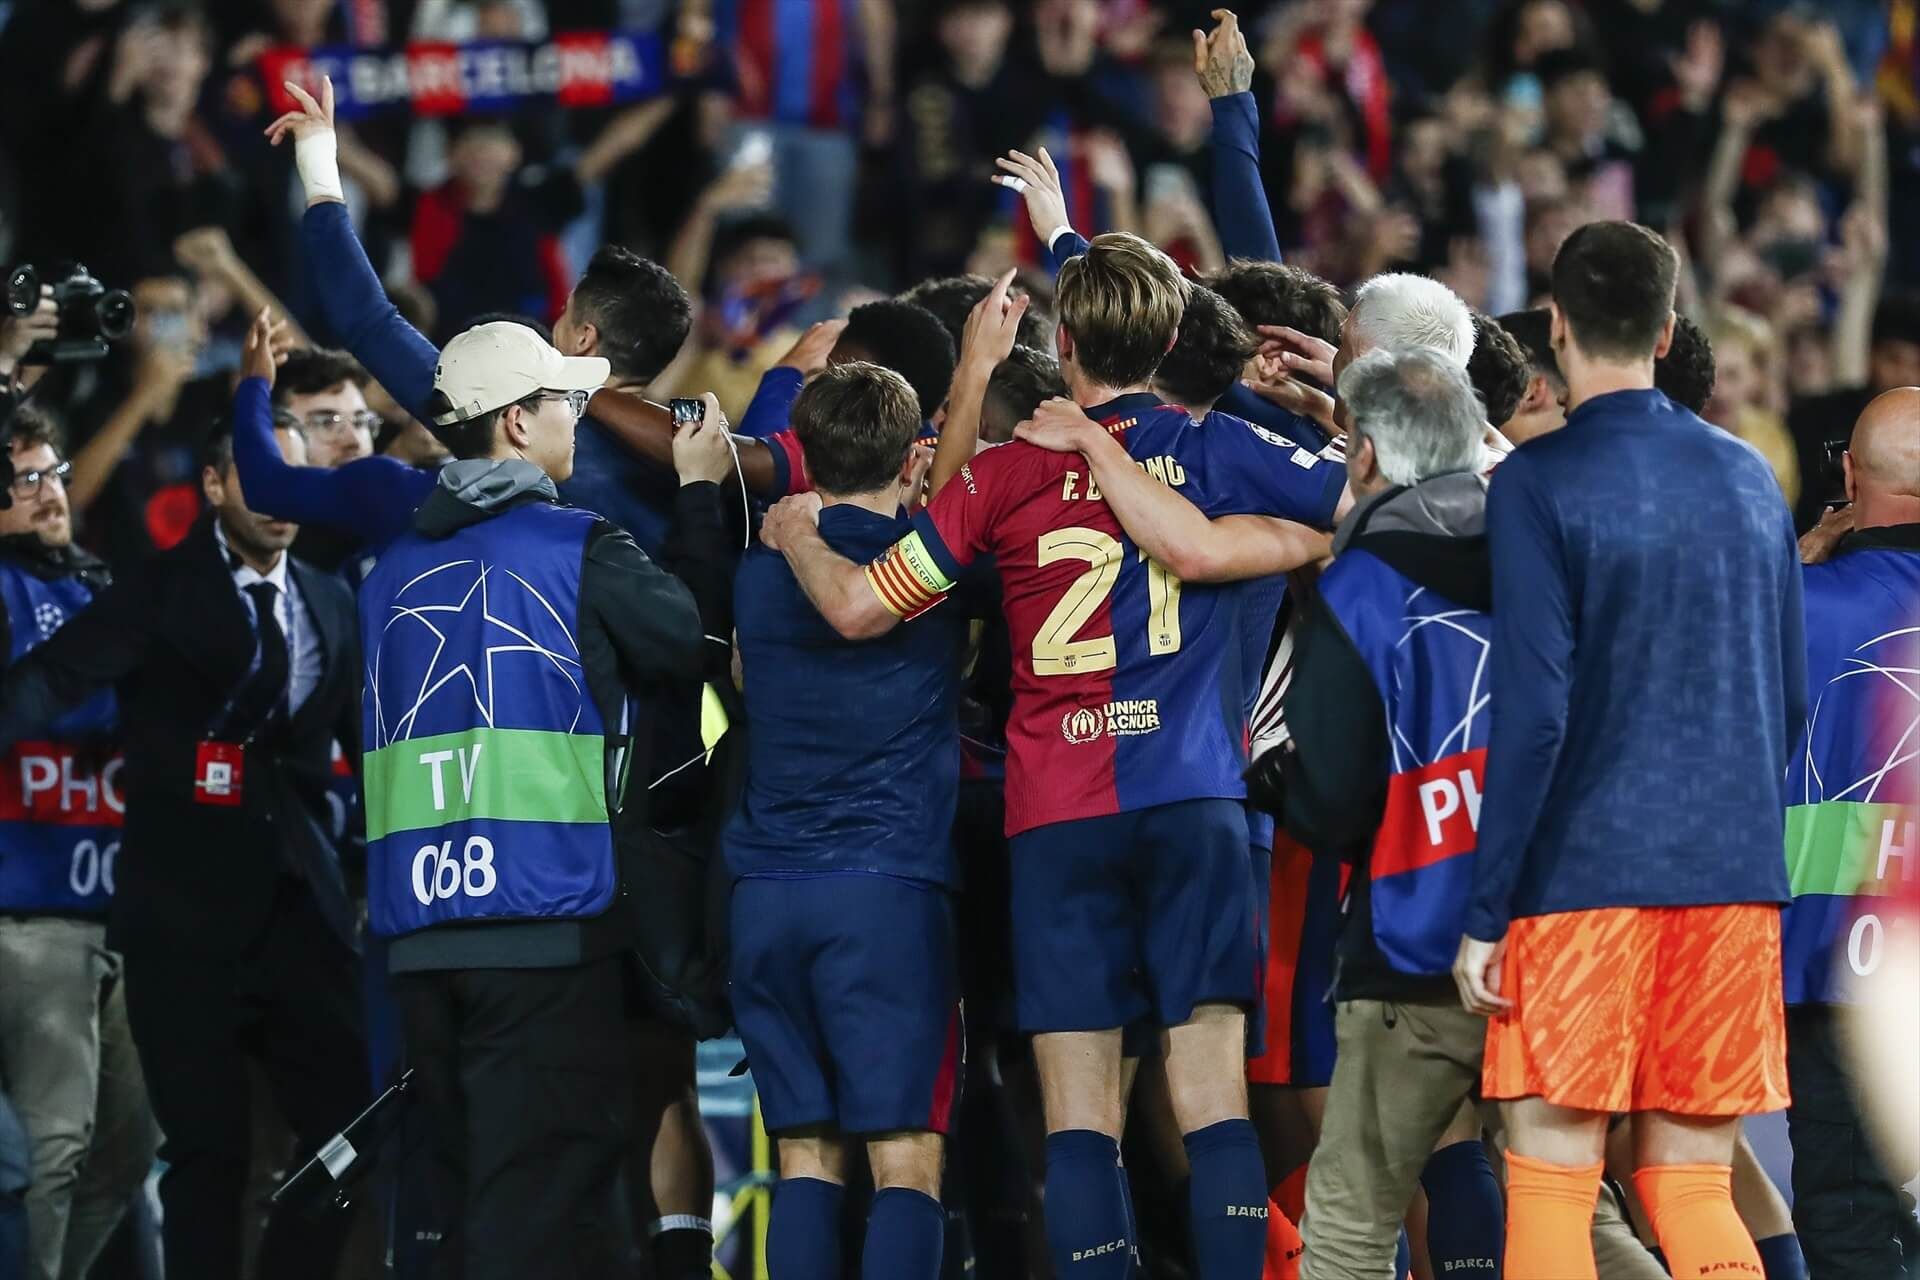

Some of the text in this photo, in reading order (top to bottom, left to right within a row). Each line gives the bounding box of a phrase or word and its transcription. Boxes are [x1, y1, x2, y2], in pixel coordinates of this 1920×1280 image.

[349, 38, 643, 103] BARCELONA
[1062, 471, 1080, 501] F.
[1031, 526, 1182, 676] 21
[1103, 700, 1158, 717] UNHCR
[1106, 714, 1160, 731] ACNUR
[419, 743, 483, 811] TV
[411, 835, 498, 906] 068
